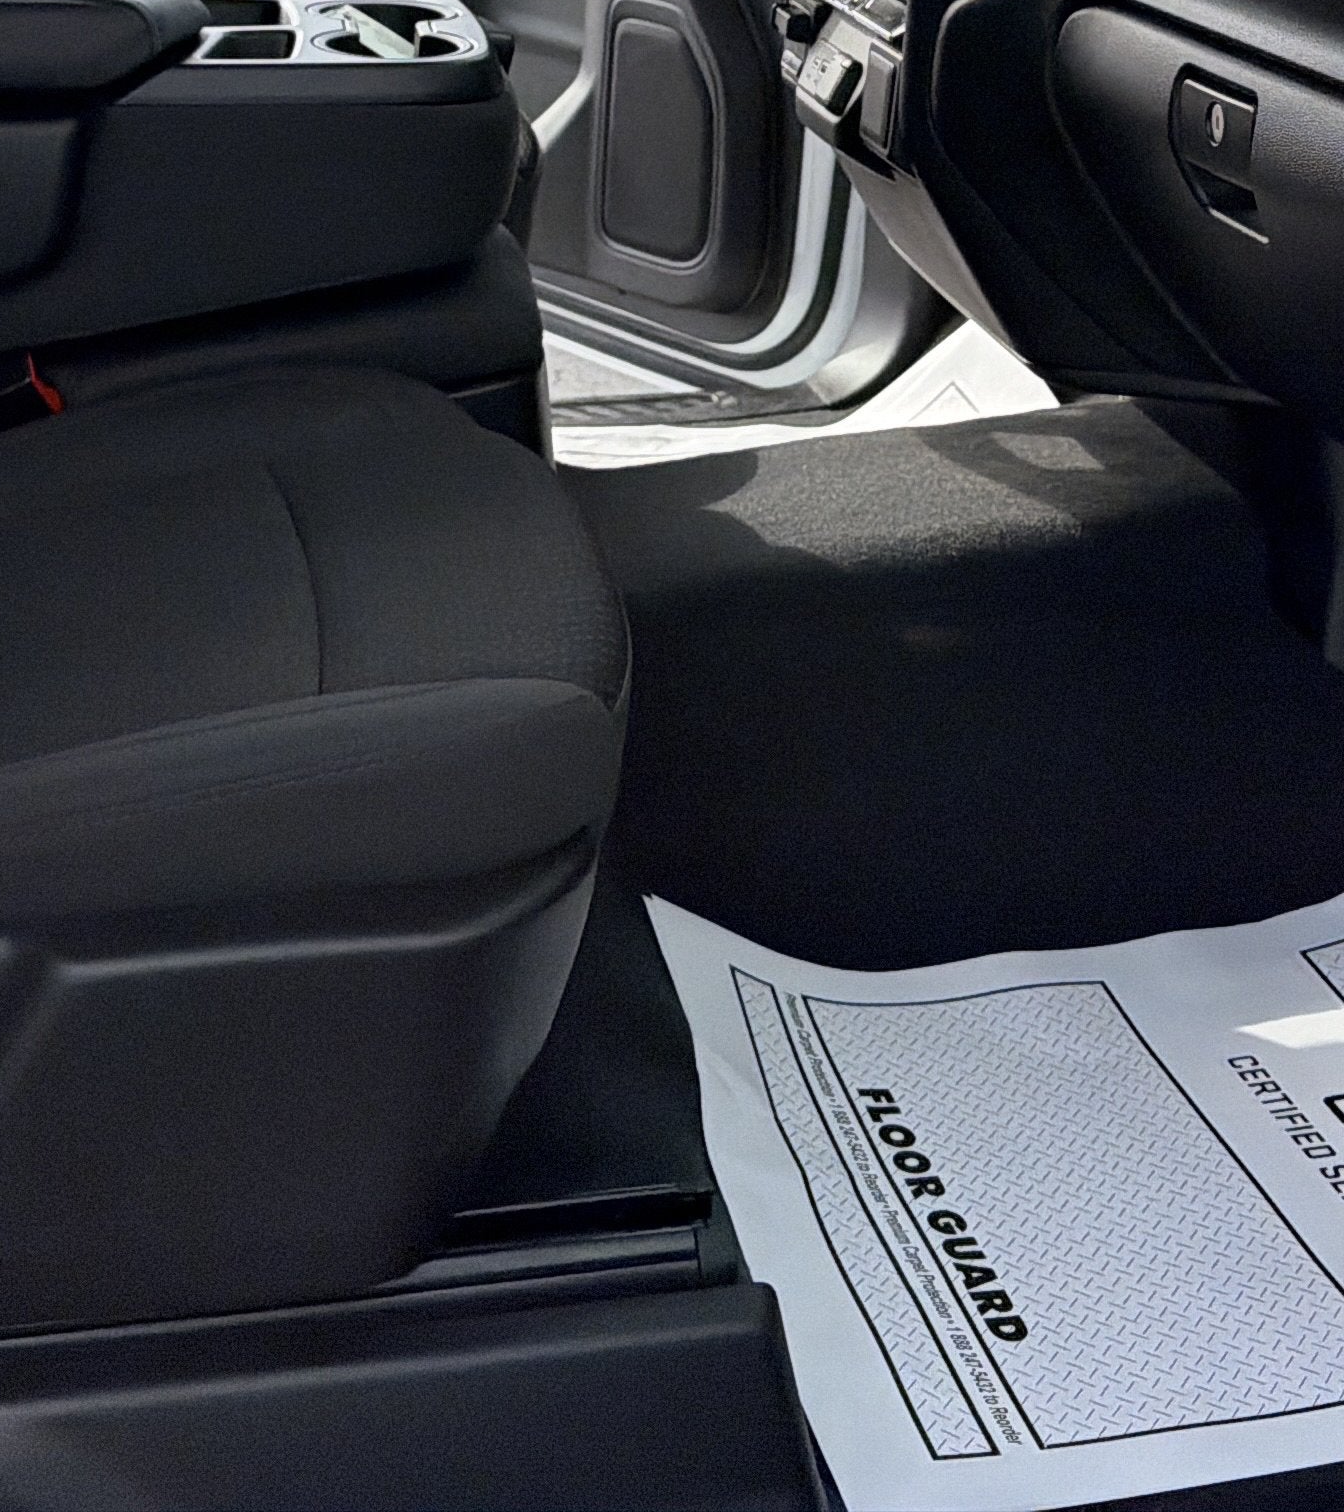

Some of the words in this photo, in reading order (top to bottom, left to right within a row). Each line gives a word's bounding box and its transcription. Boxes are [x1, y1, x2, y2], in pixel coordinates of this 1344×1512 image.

[1227, 1055, 1337, 1160] CERTIFIED
[857, 1088, 946, 1199] FLOOR
[927, 1209, 1029, 1342] GUARD
[902, 1245, 929, 1273] Carpet
[917, 1274, 953, 1319] Protection
[950, 1333, 973, 1350] 888
[959, 1352, 997, 1393] 247-5432
[982, 1395, 1000, 1405] to
[989, 1407, 1024, 1446] Reorder
